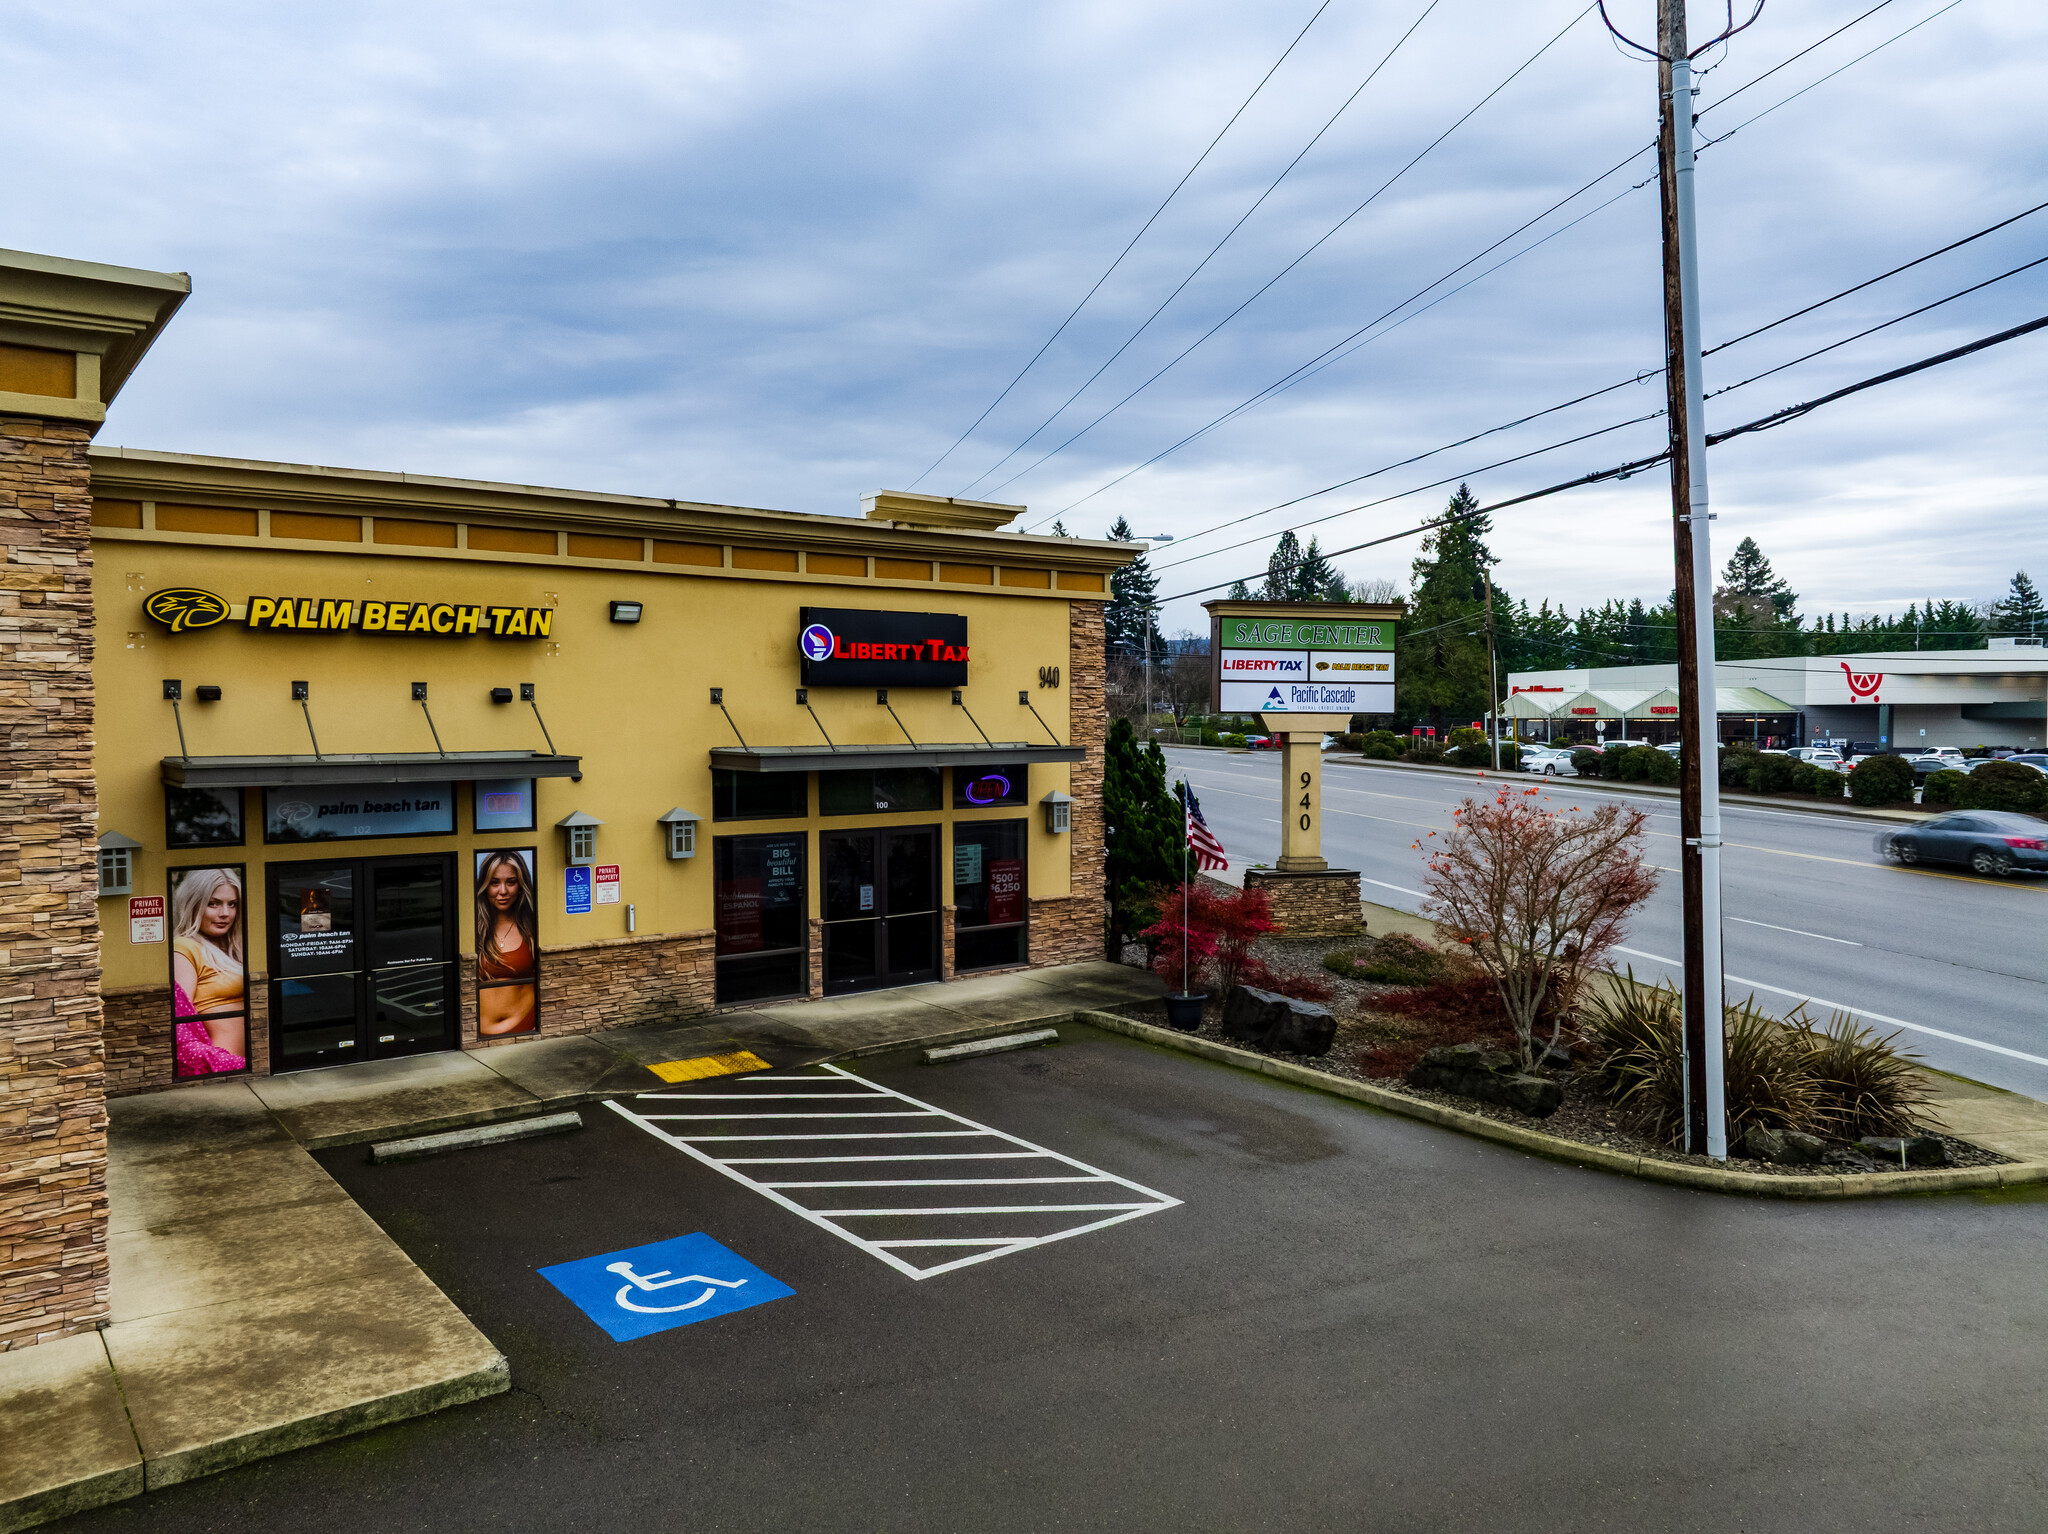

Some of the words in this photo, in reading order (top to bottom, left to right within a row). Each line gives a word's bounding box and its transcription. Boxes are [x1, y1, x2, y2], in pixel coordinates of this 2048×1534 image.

[247, 598, 353, 631] PALM
[361, 602, 479, 635] BEACH
[490, 607, 554, 637] TAN
[1235, 622, 1293, 644] SAGE
[1296, 624, 1382, 646] CENTER
[833, 635, 924, 661] LIBERTY
[926, 639, 970, 662] TAX
[1223, 659, 1303, 672] LIBERTYTAX
[1331, 663, 1350, 671] PALM
[1351, 663, 1375, 672] BEACH
[1376, 664, 1389, 672] TAN
[1039, 666, 1060, 689] 940
[1291, 685, 1319, 703] Pacific
[1320, 686, 1356, 704] Cascade
[1650, 706, 1678, 714] CENTER
[971, 780, 1003, 799] OPEN
[1299, 771, 1311, 831] 940
[317, 801, 359, 818] palm
[362, 799, 411, 814] beach
[414, 799, 440, 811] tan
[353, 825, 371, 835] 102
[772, 848, 790, 859] BIG
[766, 857, 797, 867] beautiful
[772, 866, 794, 876] BILL
[991, 873, 1013, 884] $500
[991, 882, 1021, 893] $6,250
[134, 899, 159, 908] PRIVATE
[723, 899, 760, 910] ESPAÑOL
[131, 907, 162, 916] PROPERTY
